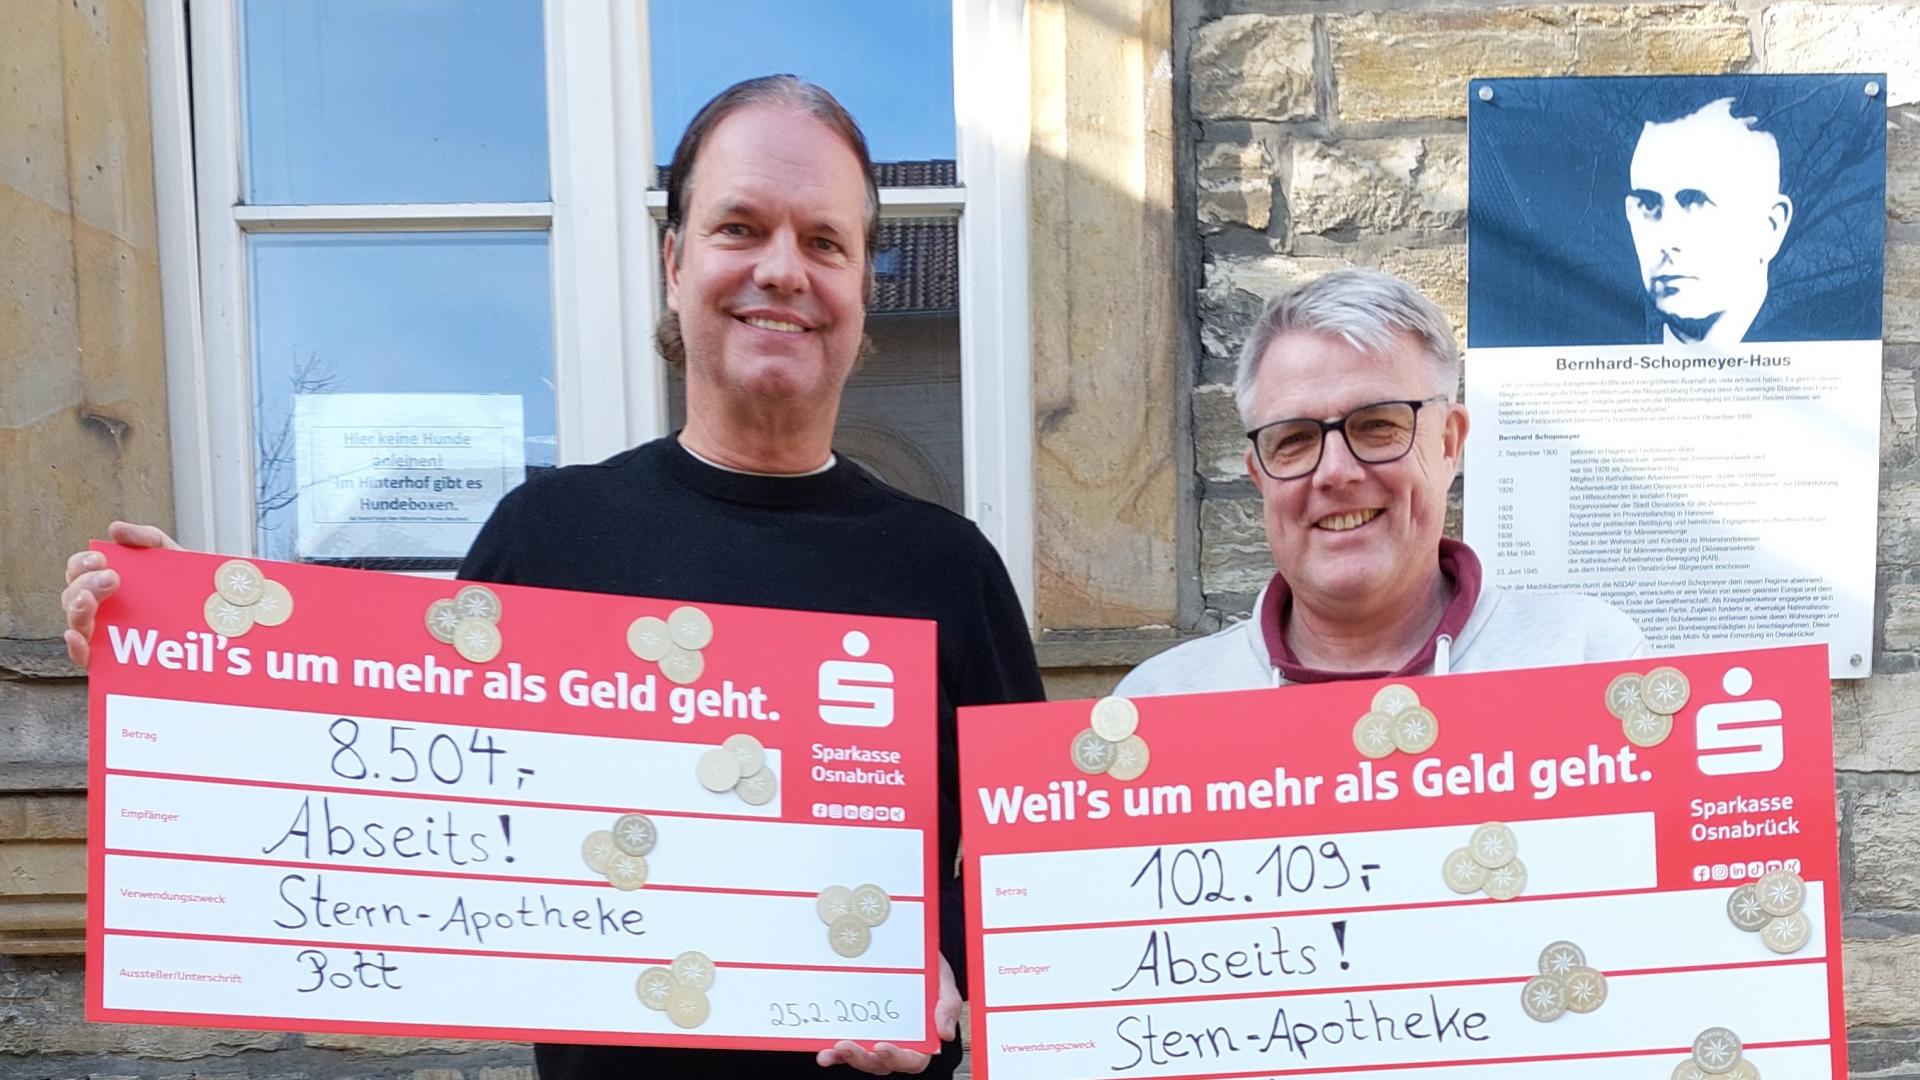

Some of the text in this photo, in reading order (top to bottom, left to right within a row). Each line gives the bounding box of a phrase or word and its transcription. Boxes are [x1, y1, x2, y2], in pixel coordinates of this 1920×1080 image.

[1557, 354, 1791, 371] Bernhard-Schopmeyer-Haus
[344, 432, 472, 445] Hier keine Hunde
[1498, 432, 1580, 442] Bernhard Schopmeyer
[373, 455, 443, 467] anleinen!
[1506, 449, 1540, 458] September
[359, 477, 430, 489] Hinterhof
[434, 477, 462, 492] gibt
[466, 480, 482, 489] es
[360, 498, 460, 511] Hundeboxen.
[266, 653, 338, 684] um
[353, 655, 473, 696] mehr
[482, 662, 547, 703] als
[558, 669, 657, 712] Geld
[669, 680, 781, 724] geht.
[121, 728, 157, 742] Betrag
[811, 743, 901, 764] Sparkasse
[811, 765, 906, 786] Osnabrück
[1123, 785, 1192, 817] um
[1206, 767, 1324, 811] mehr
[1334, 761, 1399, 802] als
[1412, 750, 1515, 798] Geld
[1530, 744, 1653, 800] geht.
[120, 808, 179, 823] Empfänger
[1690, 795, 1793, 820] Sparkasse
[262, 795, 515, 866] Abseits!
[1691, 817, 1800, 842] Osnabrück
[119, 888, 226, 905] Verwendungszweck
[995, 886, 1028, 898] Betrag
[273, 874, 648, 944] Stern-Apotheke
[119, 968, 243, 984] Aussteller/Unterschrift
[998, 963, 1051, 976] Empfänger
[770, 999, 901, 1027] 25.2.2026
[1110, 994, 1490, 1071] Stern-Apotheke
[1001, 1040, 1097, 1055] Verwendungszweck
